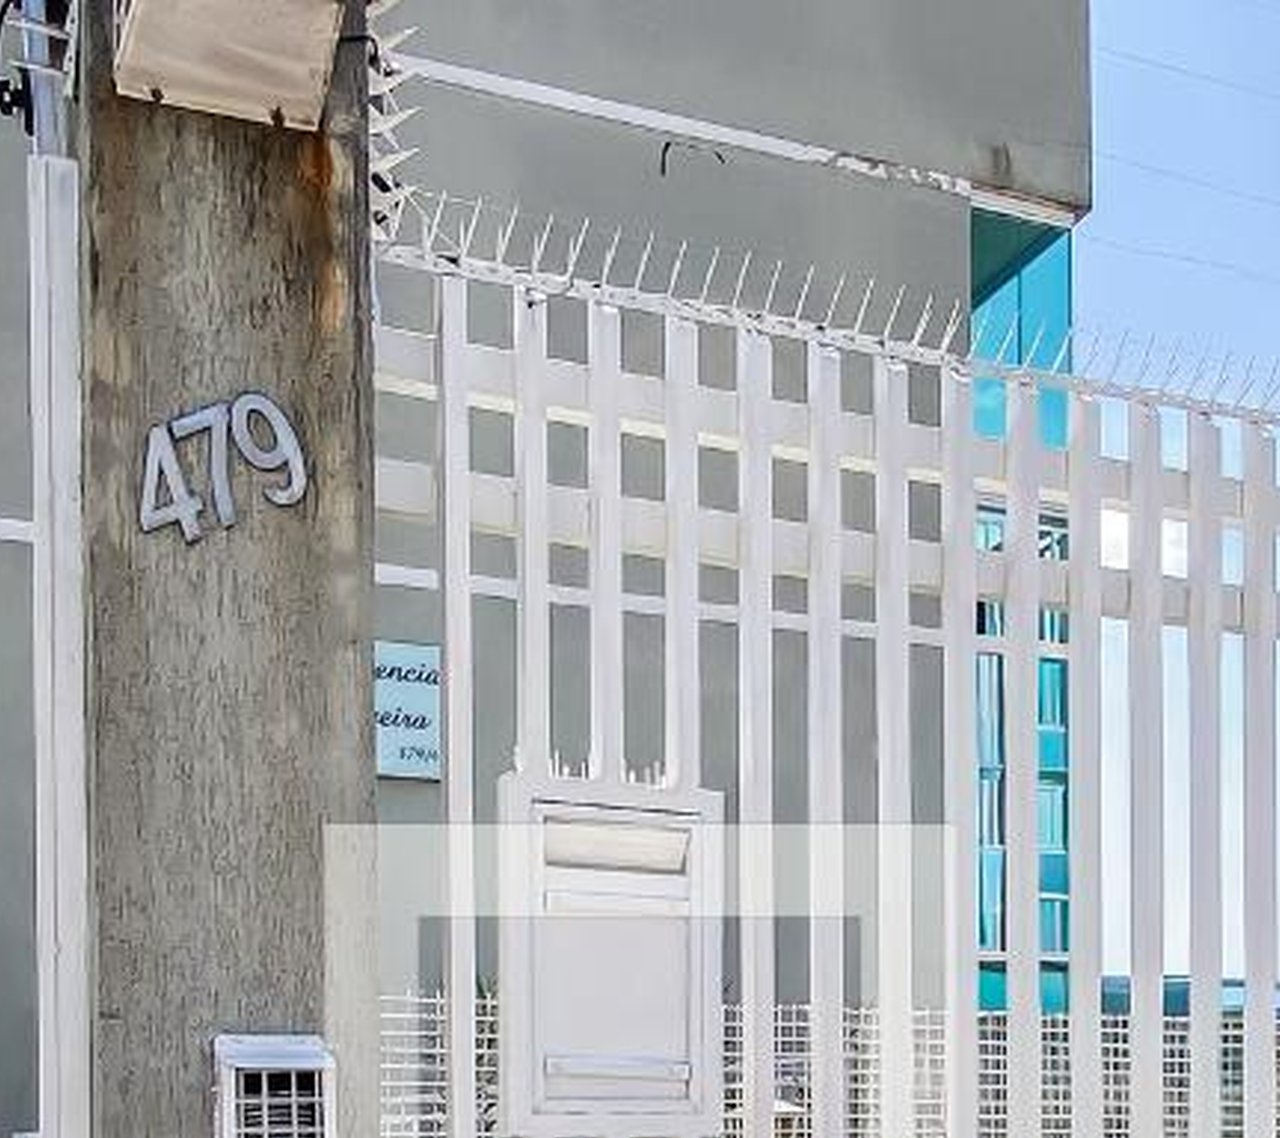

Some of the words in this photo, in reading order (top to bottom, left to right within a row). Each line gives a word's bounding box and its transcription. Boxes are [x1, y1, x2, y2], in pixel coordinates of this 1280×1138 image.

[141, 392, 307, 544] 479
[376, 663, 441, 685] encia
[375, 707, 431, 730] eira
